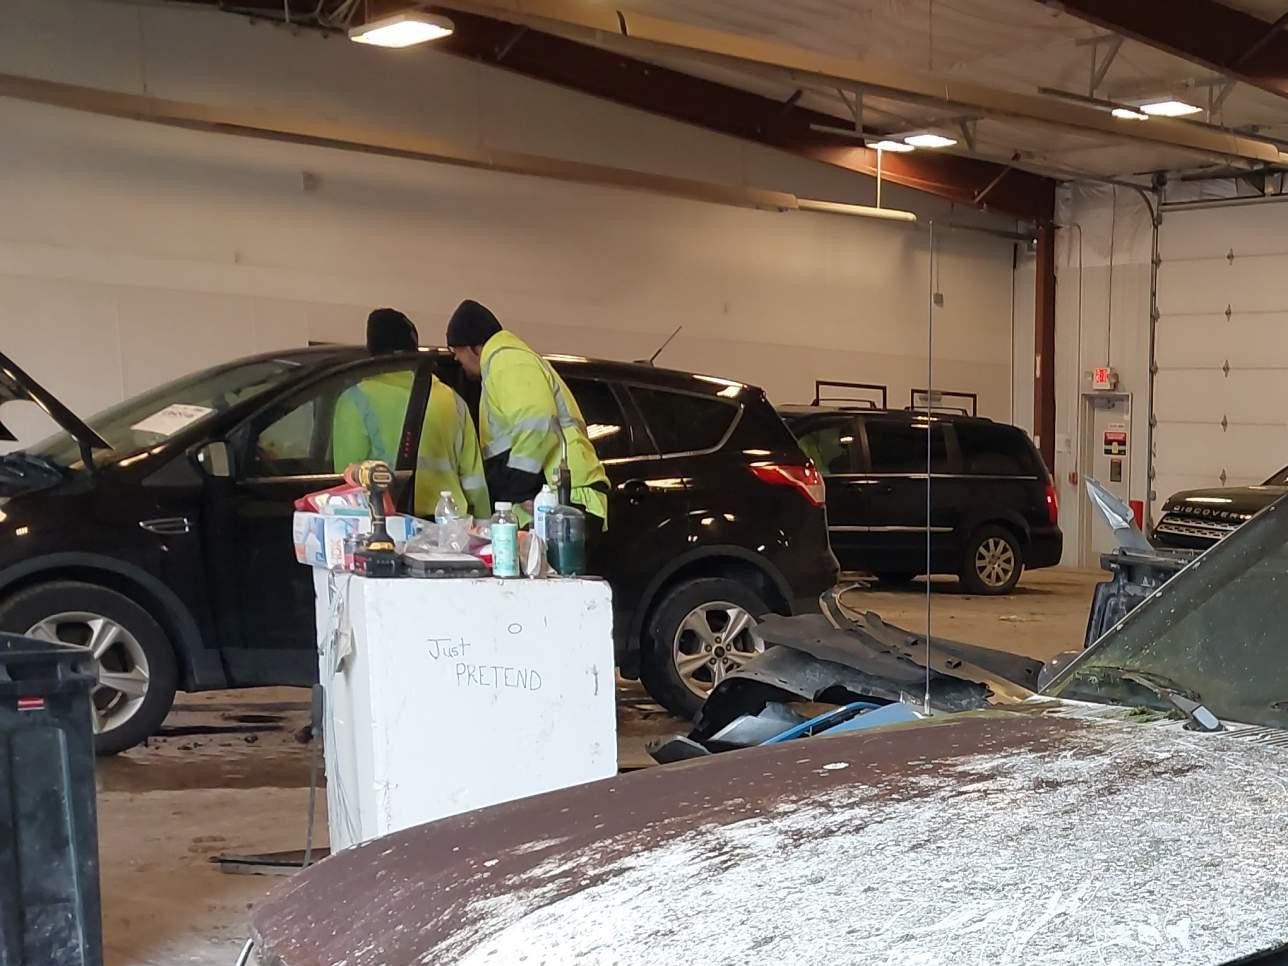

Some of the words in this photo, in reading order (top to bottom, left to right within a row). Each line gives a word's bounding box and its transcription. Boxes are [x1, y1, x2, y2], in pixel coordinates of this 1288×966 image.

[1173, 505, 1246, 520] DISCOVER
[426, 637, 471, 659] Just
[456, 662, 542, 691] PRETEND
